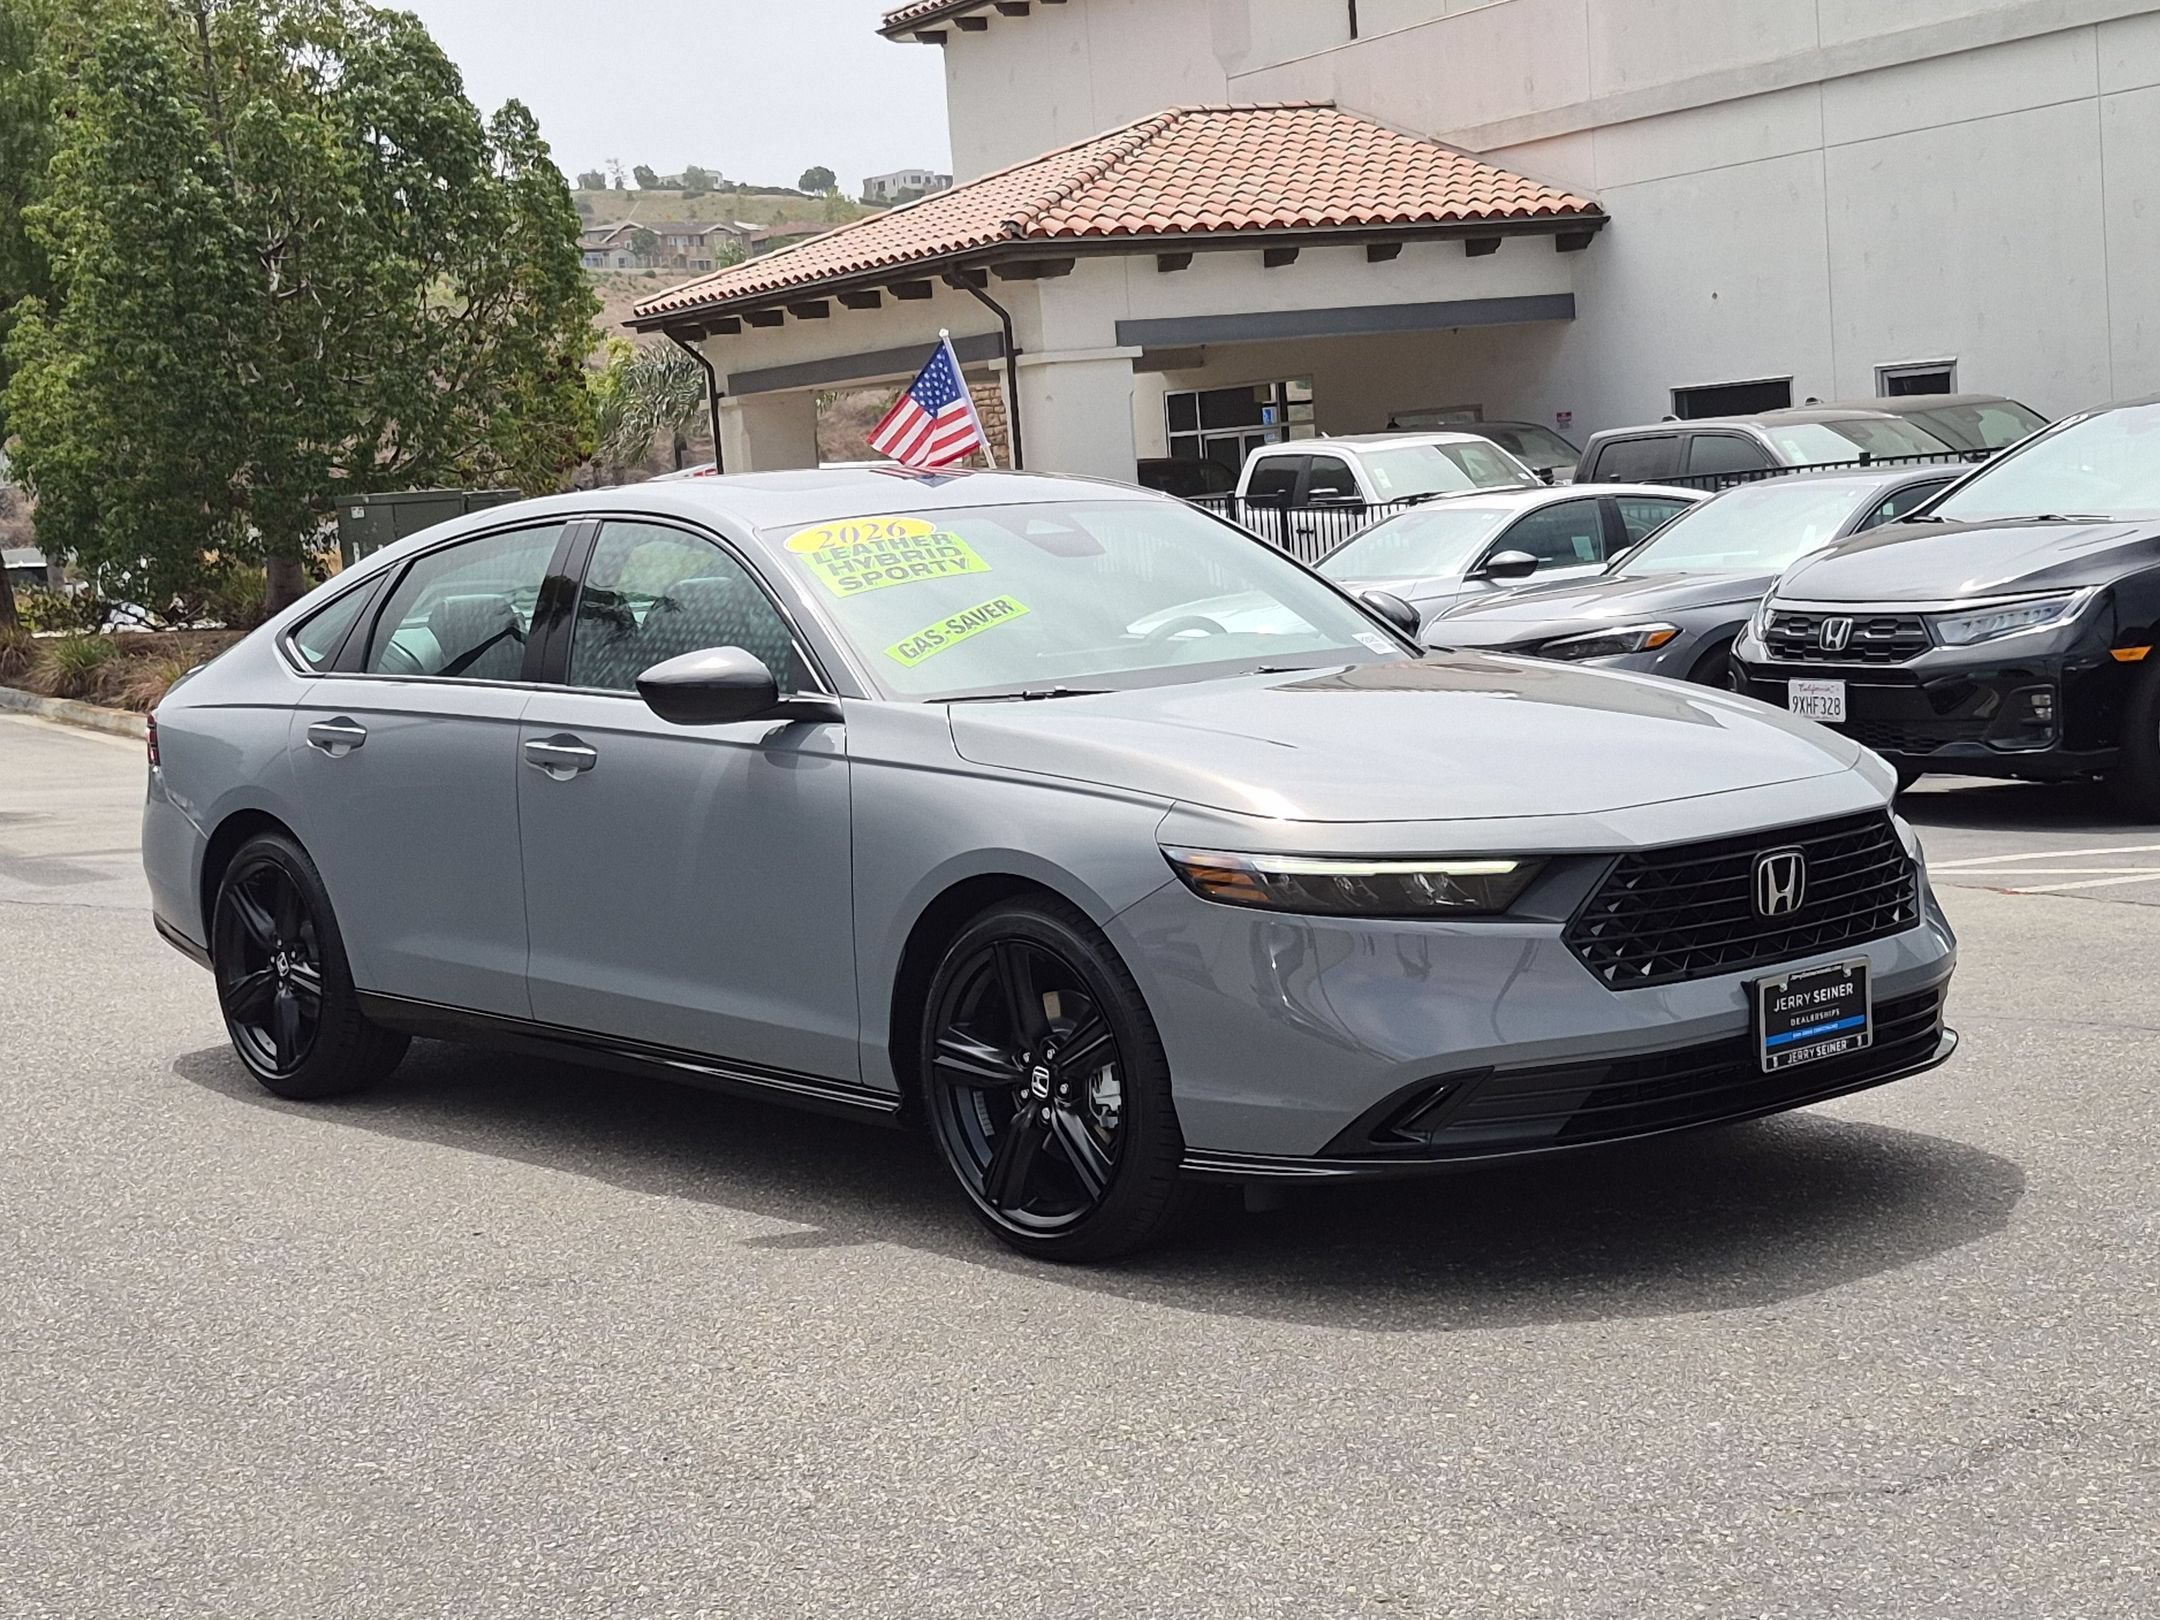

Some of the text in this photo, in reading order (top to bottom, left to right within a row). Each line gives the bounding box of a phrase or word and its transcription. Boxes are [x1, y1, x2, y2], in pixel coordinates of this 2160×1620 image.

[812, 533, 954, 565] LEATHER
[817, 520, 907, 550] 2026
[827, 546, 963, 577] HYBRID
[838, 558, 969, 591] SPORTY
[1792, 695, 1842, 716] 9XHF328
[1773, 982, 1854, 1012] JERRY SEINER
[1790, 1008, 1840, 1026] DEALERSHIPS
[1788, 1039, 1847, 1064] JERRY SEINER
